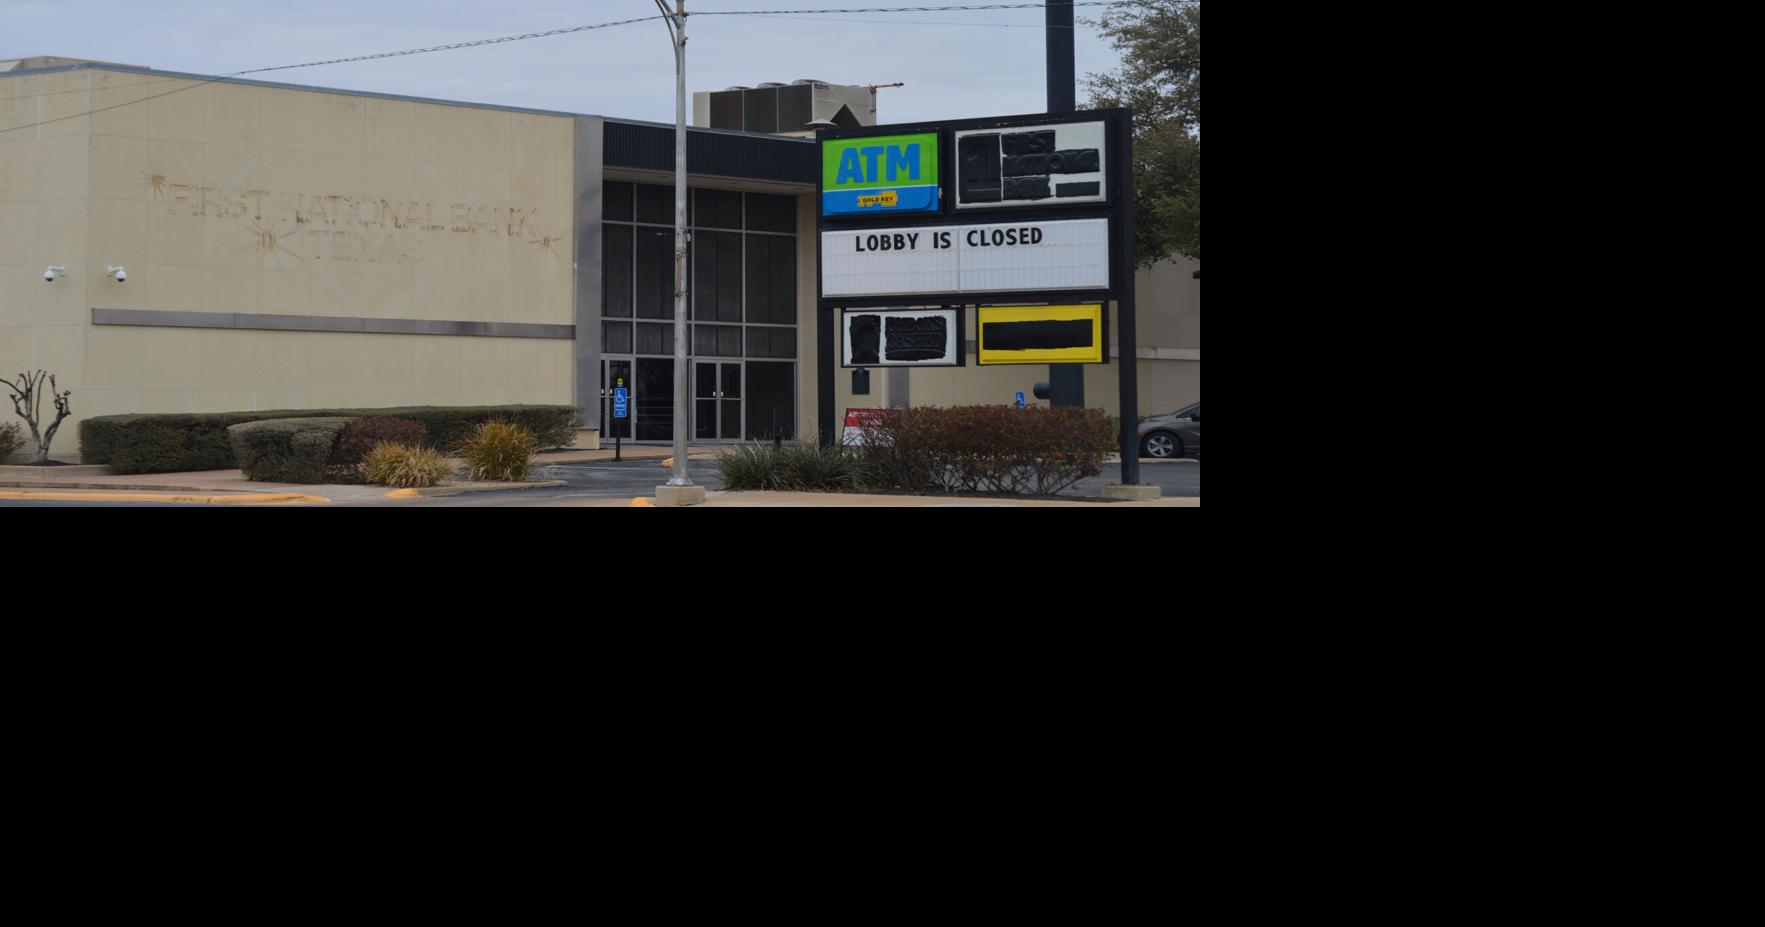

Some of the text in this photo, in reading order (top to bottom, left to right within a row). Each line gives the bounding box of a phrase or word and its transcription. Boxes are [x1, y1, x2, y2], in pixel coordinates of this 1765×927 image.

[836, 143, 920, 184] ATM
[863, 195, 894, 203] GOLD KEY
[855, 227, 1042, 252] LOBBY IS CLOSED
